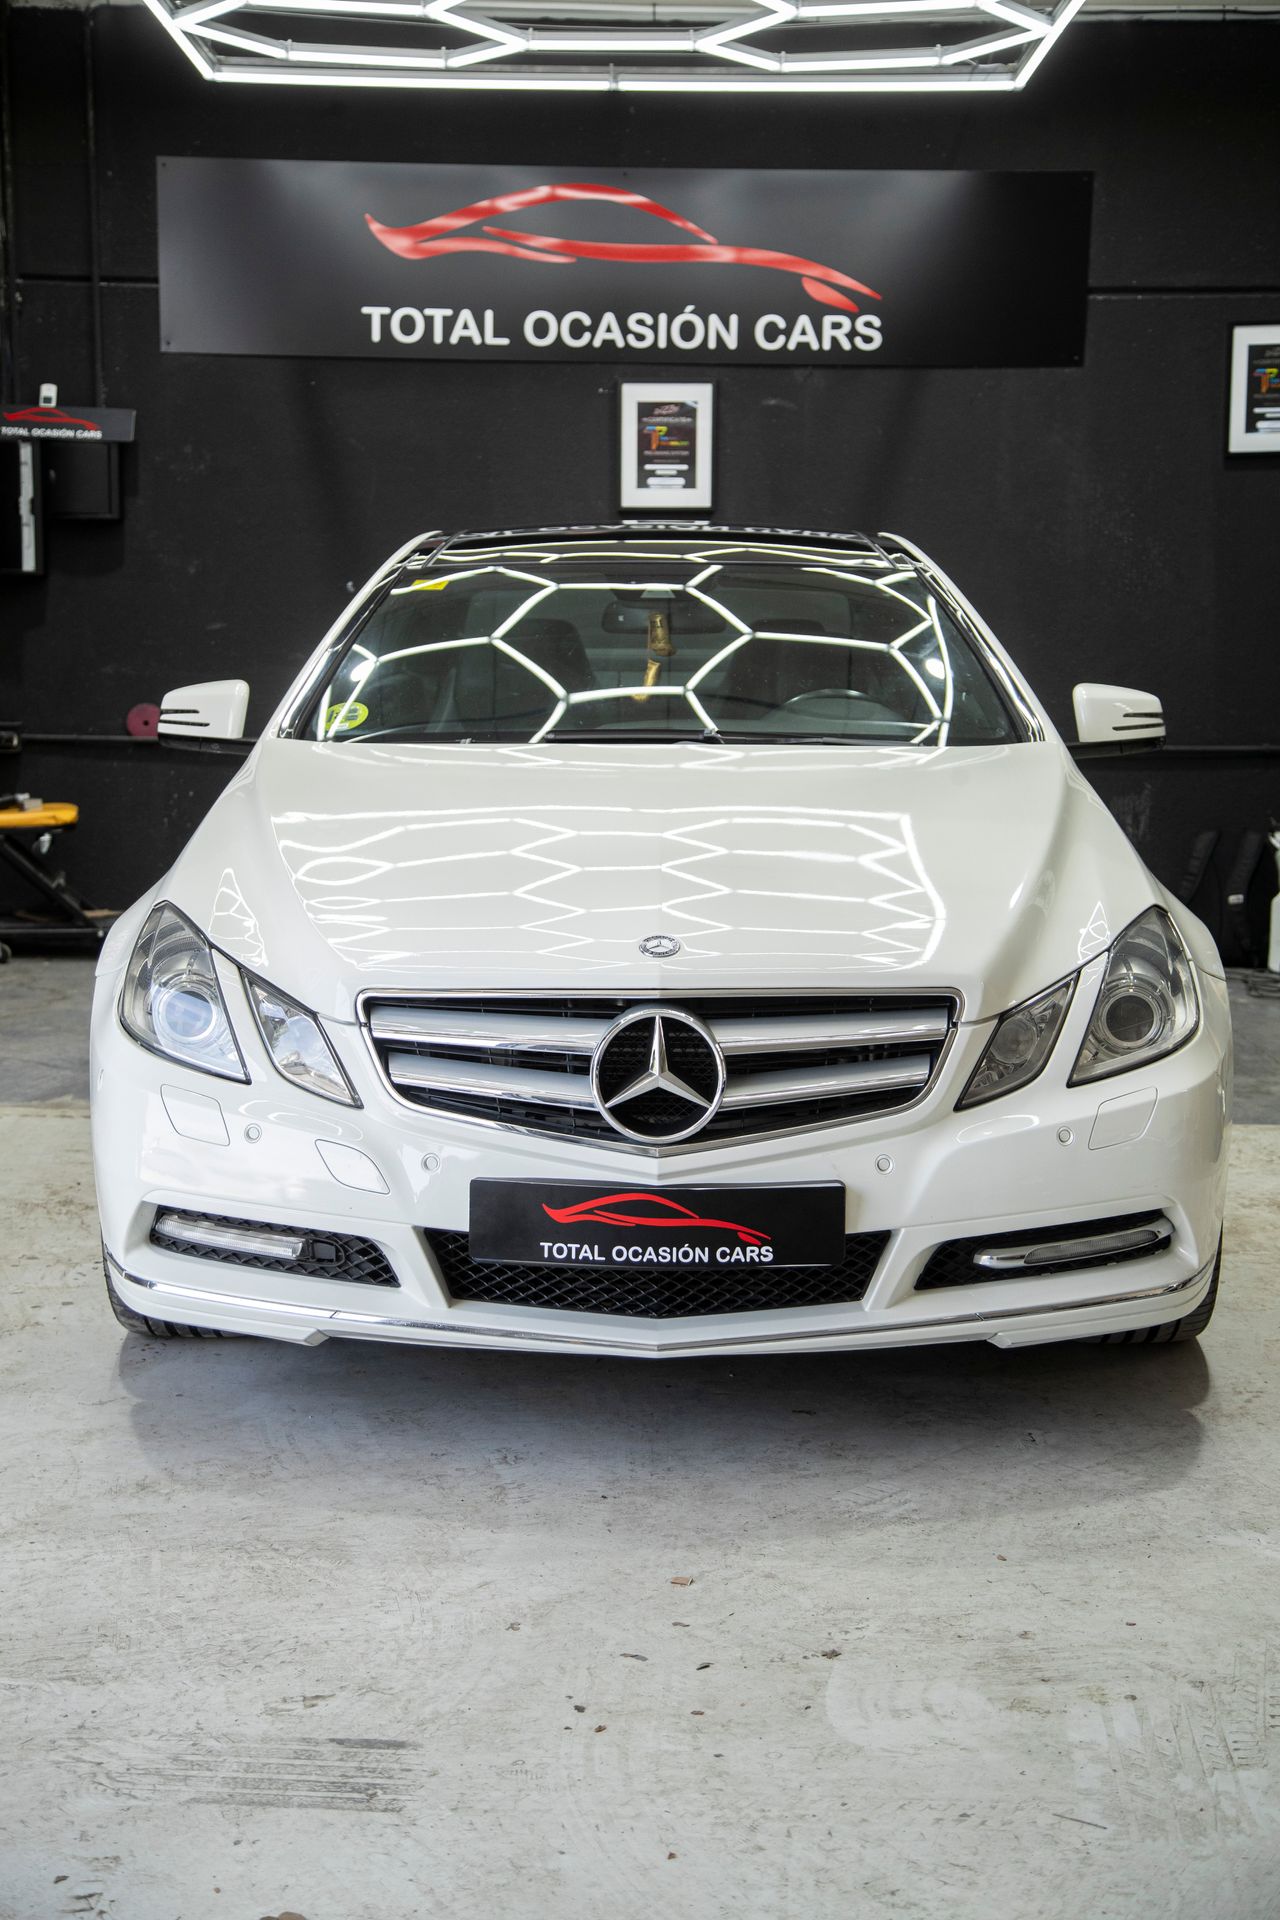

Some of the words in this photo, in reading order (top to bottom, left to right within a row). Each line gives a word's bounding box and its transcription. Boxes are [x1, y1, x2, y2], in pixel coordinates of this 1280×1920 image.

[361, 306, 510, 346] TOTAL
[523, 304, 739, 350] OCASIÓN
[754, 313, 883, 351] CARS
[1, 426, 29, 437] TOTAL
[76, 429, 102, 440] CARS
[540, 1242, 605, 1262] TOTAL
[611, 1243, 709, 1263] OCASIÓN
[716, 1245, 774, 1263] CARS
